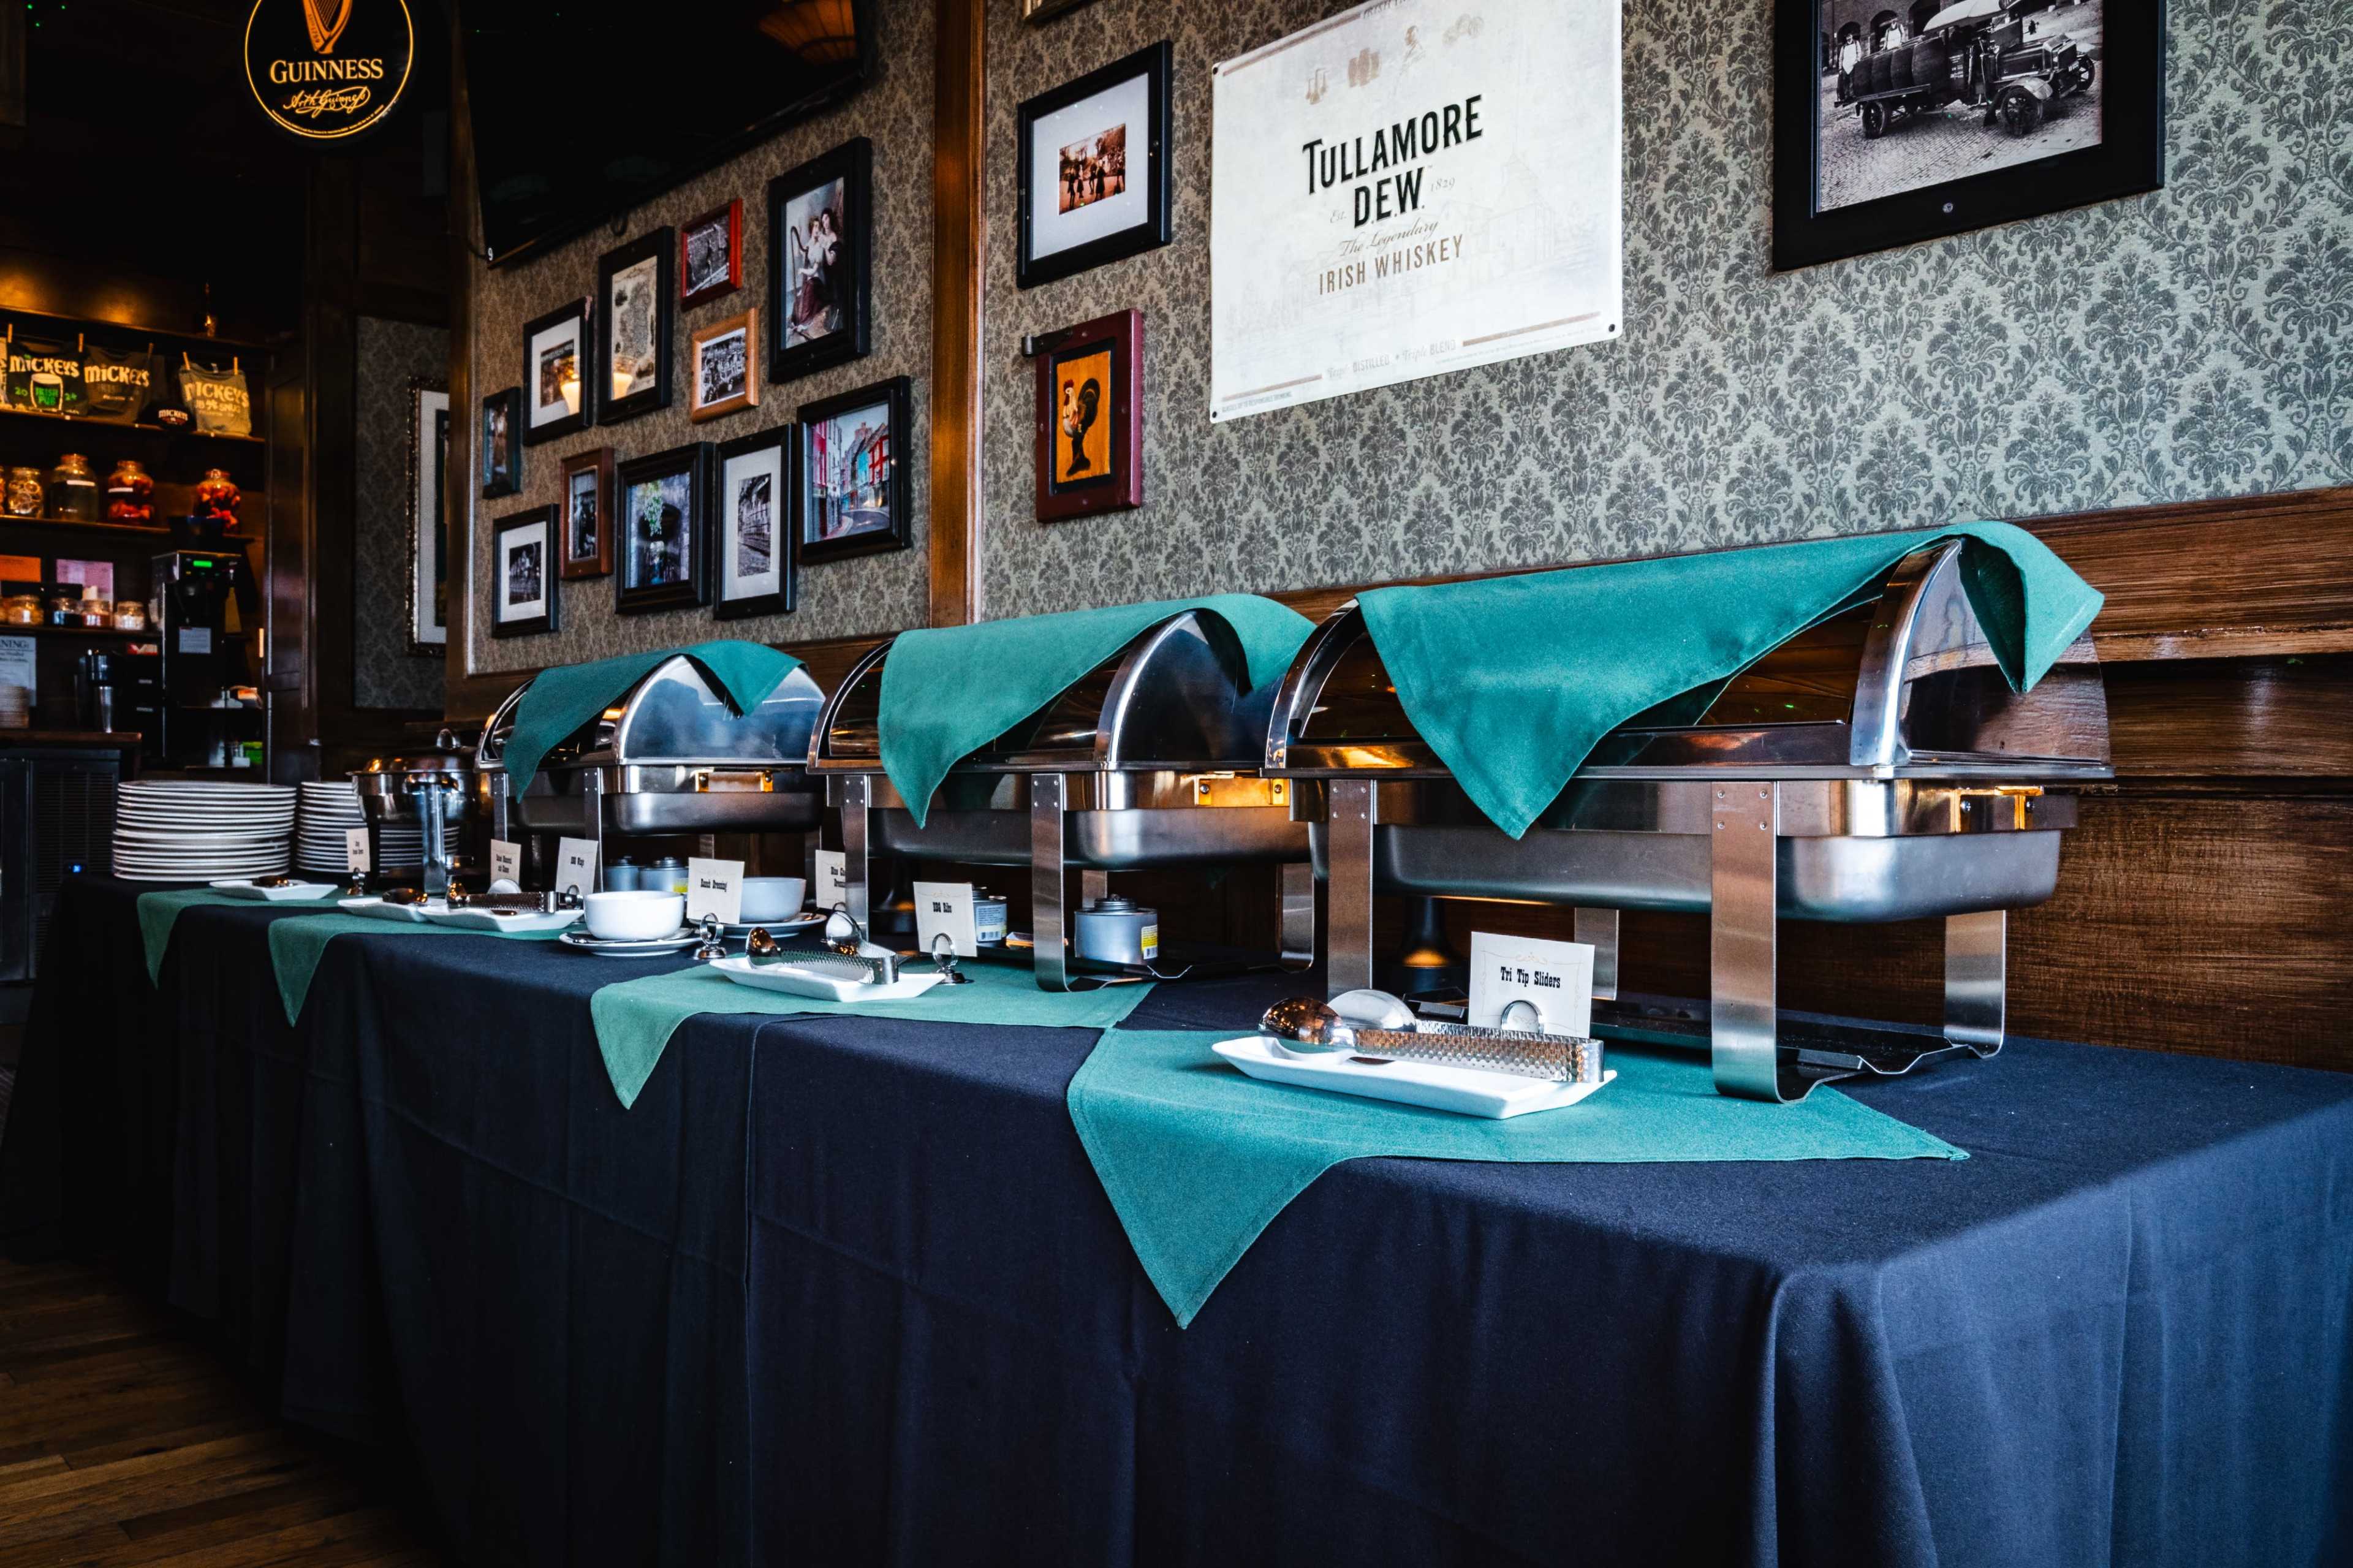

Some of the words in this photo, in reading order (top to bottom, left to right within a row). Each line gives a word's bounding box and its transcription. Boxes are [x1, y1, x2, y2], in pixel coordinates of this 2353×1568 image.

[270, 58, 384, 84] GUINNESS
[1302, 94, 1483, 195] TULLAMORE
[1430, 178, 1456, 192] 1829
[1339, 230, 1366, 257] The
[1366, 216, 1439, 254] Legendary
[1319, 260, 1366, 295] IRISH
[1375, 233, 1463, 279] WHISKEY
[1352, 354, 1391, 374] DISTILLED
[1402, 345, 1428, 363] Triple
[1429, 339, 1457, 356] BLEND
[1501, 966, 1512, 982] Tri
[1517, 968, 1529, 987] Tip
[1534, 971, 1561, 988] Sliders
